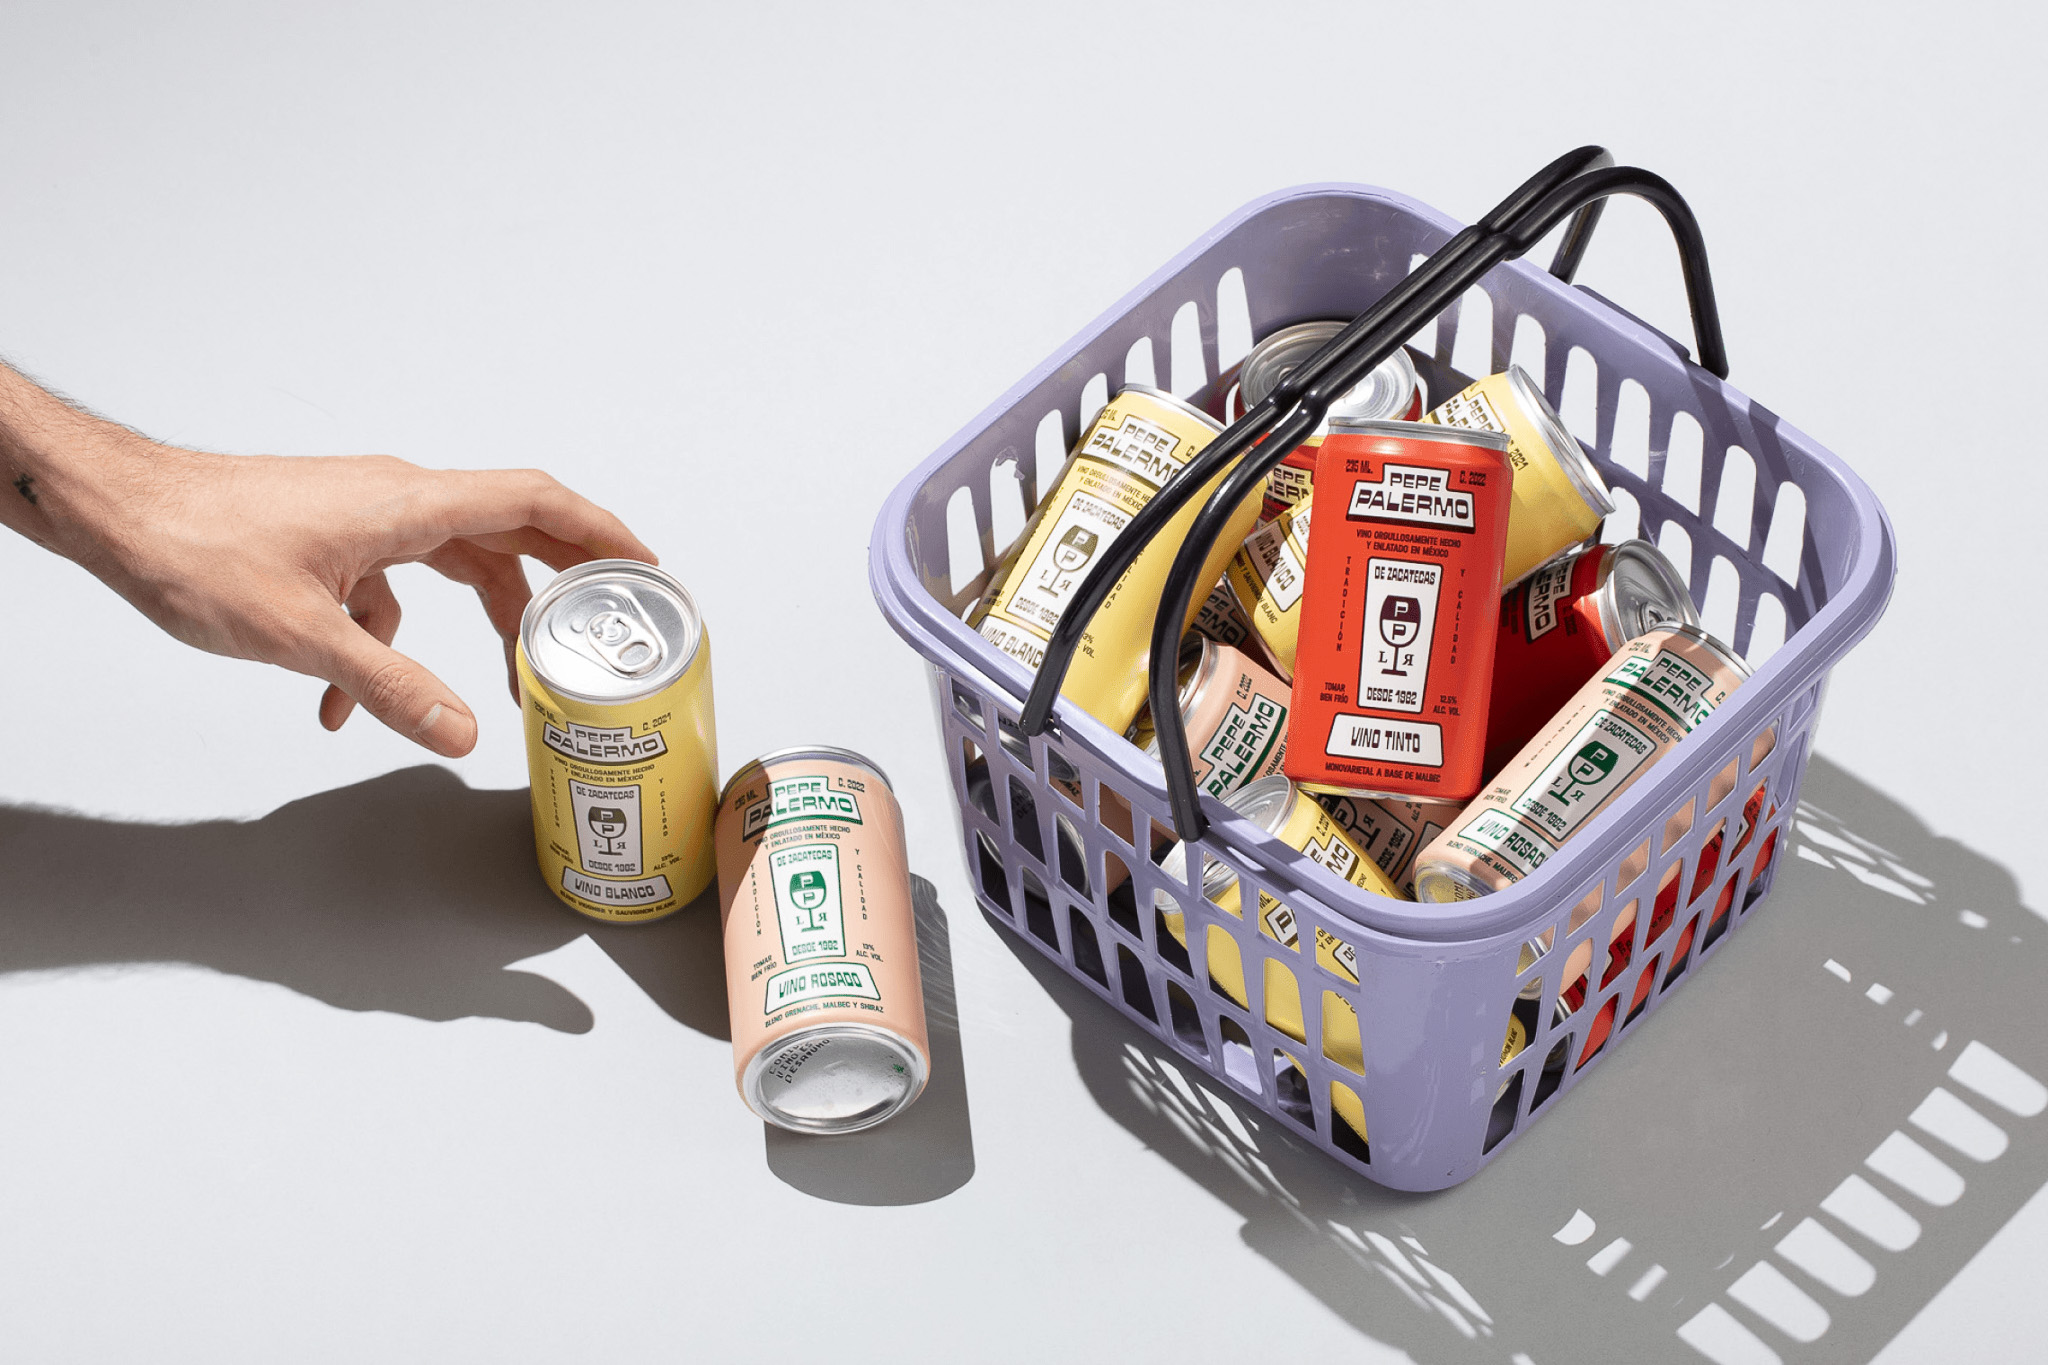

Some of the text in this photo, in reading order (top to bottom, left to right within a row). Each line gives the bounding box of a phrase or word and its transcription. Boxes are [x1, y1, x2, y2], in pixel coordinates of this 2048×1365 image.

[1123, 423, 1169, 452] PEPE
[1274, 467, 1305, 485] EPE
[1390, 473, 1442, 491] PEPE
[1123, 494, 1145, 511] MÉXIC
[1355, 489, 1470, 520] PALERMO
[1356, 529, 1461, 548] VINO ORGULLOSAMENTE HECHO
[1366, 541, 1449, 558] Y ENLATADO EN MÉXICO
[1262, 545, 1296, 591] BLANCO
[1374, 566, 1436, 585] DE ZACATECAS
[1261, 602, 1278, 624] BLANC
[1003, 635, 1044, 669] BLANC
[1656, 657, 1702, 691] PEPE
[1324, 682, 1346, 692] TOMAR
[1366, 687, 1417, 705] DESDE 1982
[1319, 693, 1333, 702] BIEN
[652, 712, 672, 728] 2021
[575, 729, 625, 743] PEPE
[1211, 714, 1246, 761] PEPE
[1351, 726, 1421, 753] VINO TINTO
[1604, 720, 1648, 754] ZACATECAS
[1637, 716, 1647, 725] EN
[1647, 722, 1670, 744] MÉXICO
[1666, 724, 1683, 742] HECH
[549, 730, 659, 758] PALERMO
[1207, 702, 1275, 800] PALERMO
[569, 764, 632, 776] ORGULLOSAMENTE
[633, 764, 655, 774] HECHO
[571, 769, 603, 782] ENLATADO
[617, 774, 644, 783] MÉXICO
[1325, 762, 1441, 783] MONOVARIETAL A BASE DE MALBEC
[576, 786, 635, 800] DE ZACATECAS
[774, 782, 821, 798] PEPE
[748, 796, 854, 826] PALERMO
[1522, 798, 1547, 818] DESDE
[753, 825, 851, 847] VINO ORGULLOSAMENTE HECHO
[771, 833, 803, 848] ENLATADO
[816, 831, 840, 840] MÉXICO
[1477, 819, 1550, 868] VINO ROSAD
[588, 860, 613, 872] DESDE
[777, 850, 833, 867] DE ZACATECAS
[1493, 861, 1519, 884] MALBEC
[575, 878, 656, 900] VINO BLANCO
[791, 942, 816, 956] DESDE
[753, 955, 772, 969] TOMAR
[779, 972, 862, 998] VINO ROSADO
[765, 1014, 783, 1028] BLEND
[823, 1001, 850, 1009] MALBEC
[860, 1002, 884, 1013] SHIRAZ
